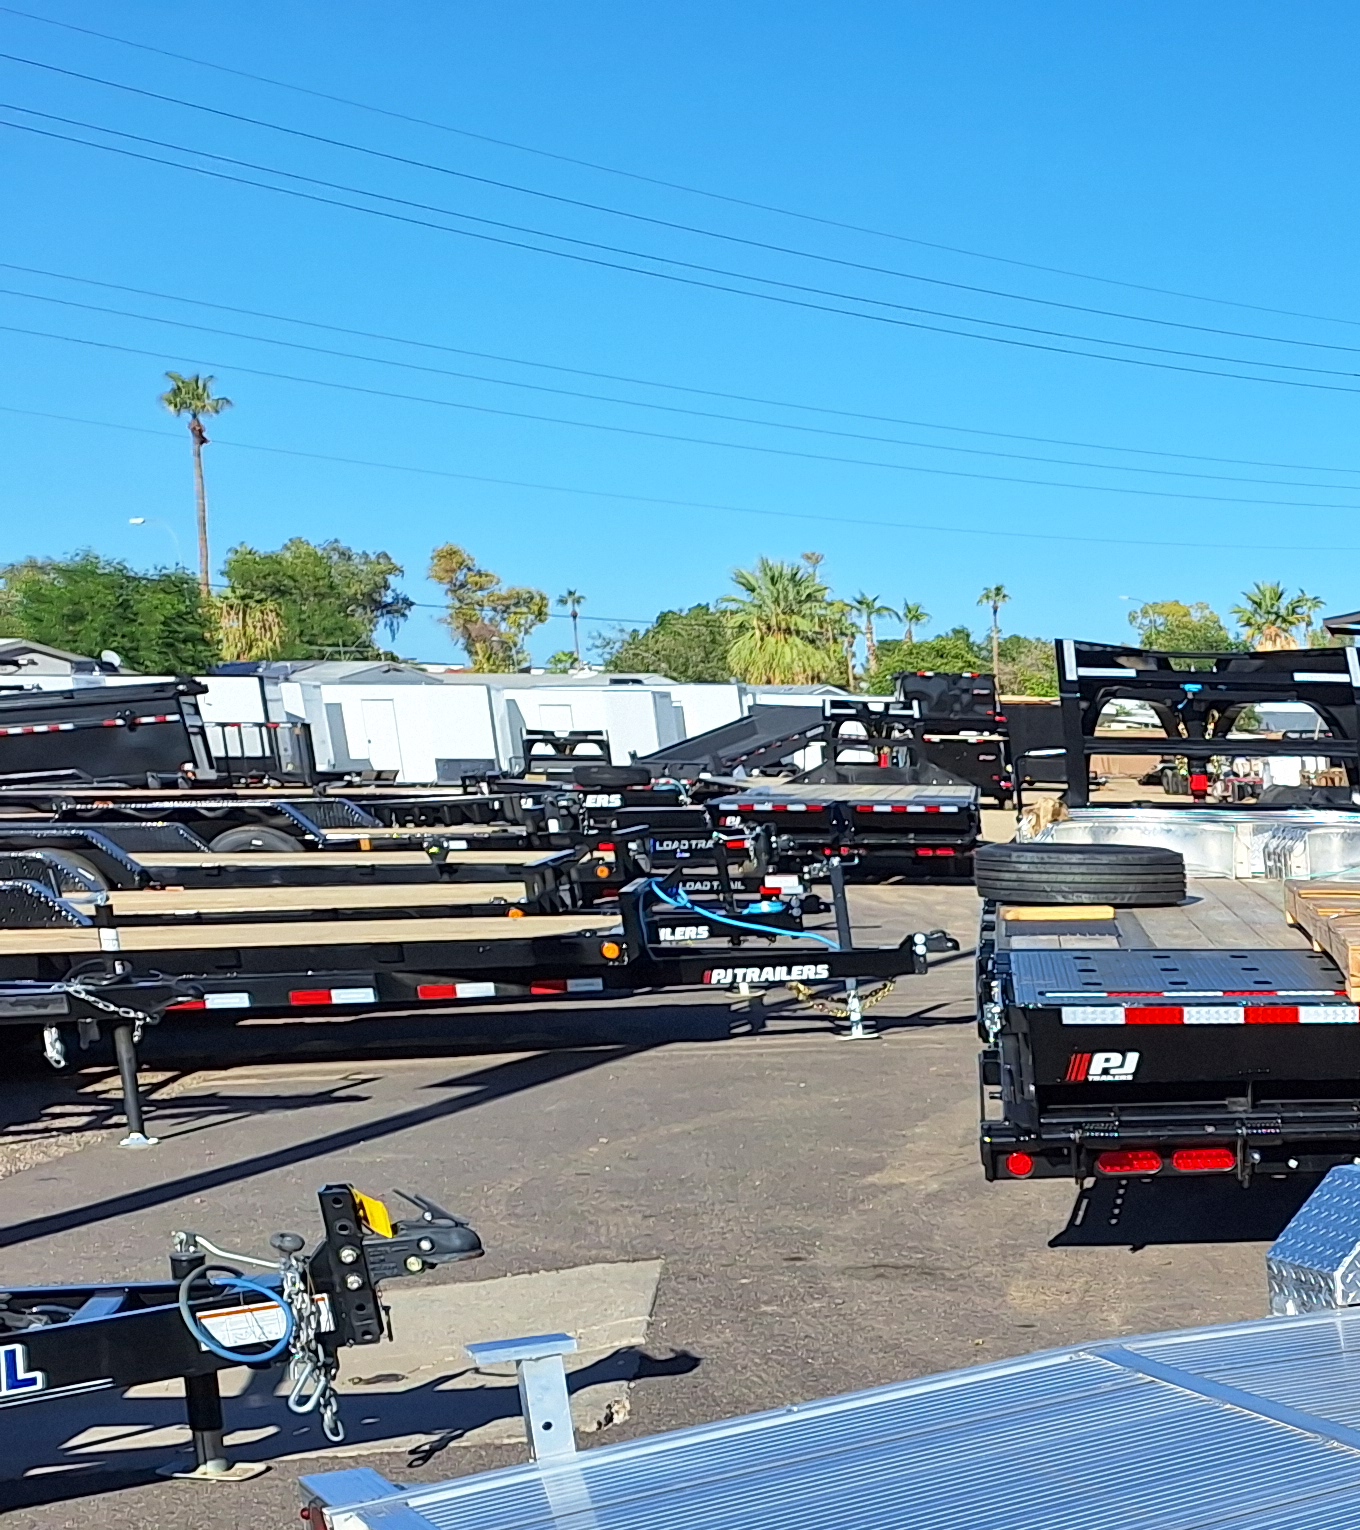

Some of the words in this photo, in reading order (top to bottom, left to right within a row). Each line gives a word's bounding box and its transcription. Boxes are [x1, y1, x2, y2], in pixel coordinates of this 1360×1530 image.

[656, 840, 689, 851] LOAD
[690, 839, 715, 850] TRA
[679, 881, 711, 891] LOAD
[659, 926, 709, 941] ILERS
[710, 968, 733, 984] PJ
[733, 964, 830, 982] TRAILERS
[1089, 1052, 1140, 1075] PJ
